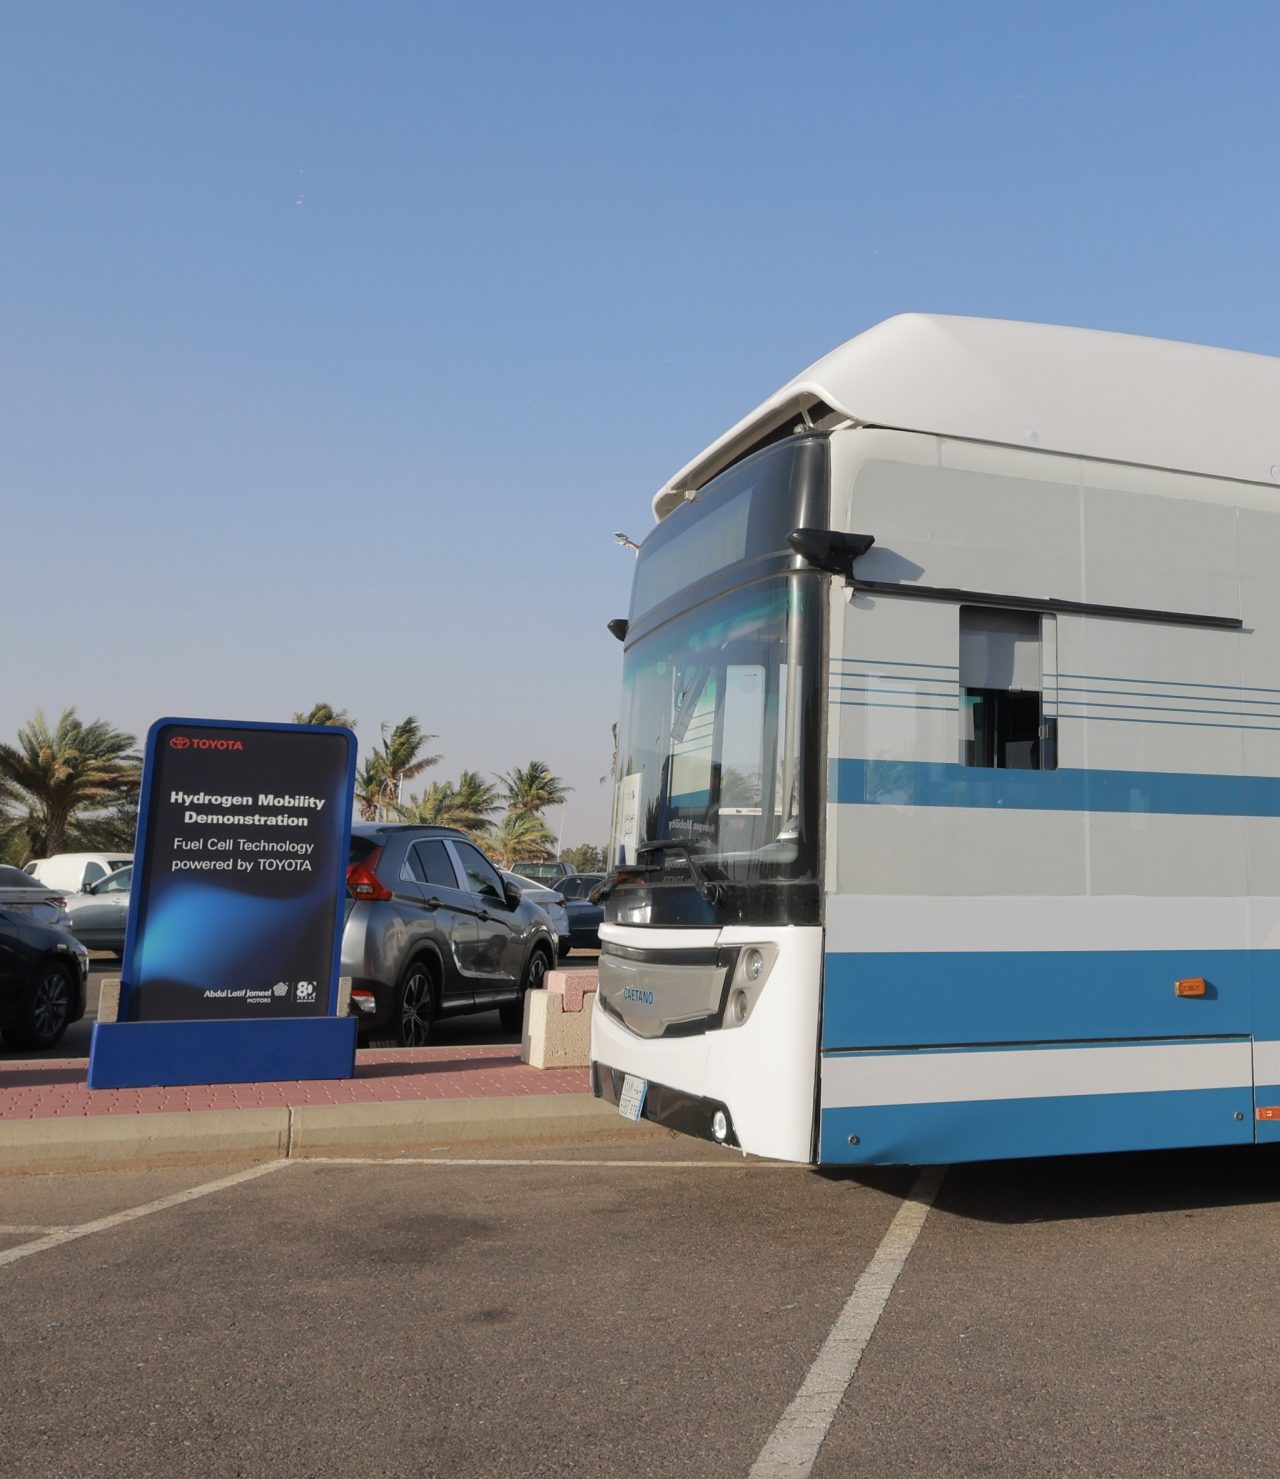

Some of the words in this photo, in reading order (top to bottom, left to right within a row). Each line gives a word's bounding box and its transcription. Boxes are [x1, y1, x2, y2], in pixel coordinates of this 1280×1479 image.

[192, 739, 243, 750] TOYOTA
[170, 791, 253, 807] Hydrogen
[258, 794, 325, 810] Mobility
[184, 811, 308, 826] Demonstration
[174, 838, 203, 850] Fuel
[207, 838, 233, 850] Cell
[237, 839, 314, 854] Technology
[171, 858, 233, 872] powered
[237, 859, 254, 873] by
[258, 859, 312, 871] TOYOTA
[203, 990, 227, 998] Abdul
[228, 989, 246, 997] Latif
[246, 989, 272, 998] Jameel
[624, 987, 654, 1004] CAETANO
